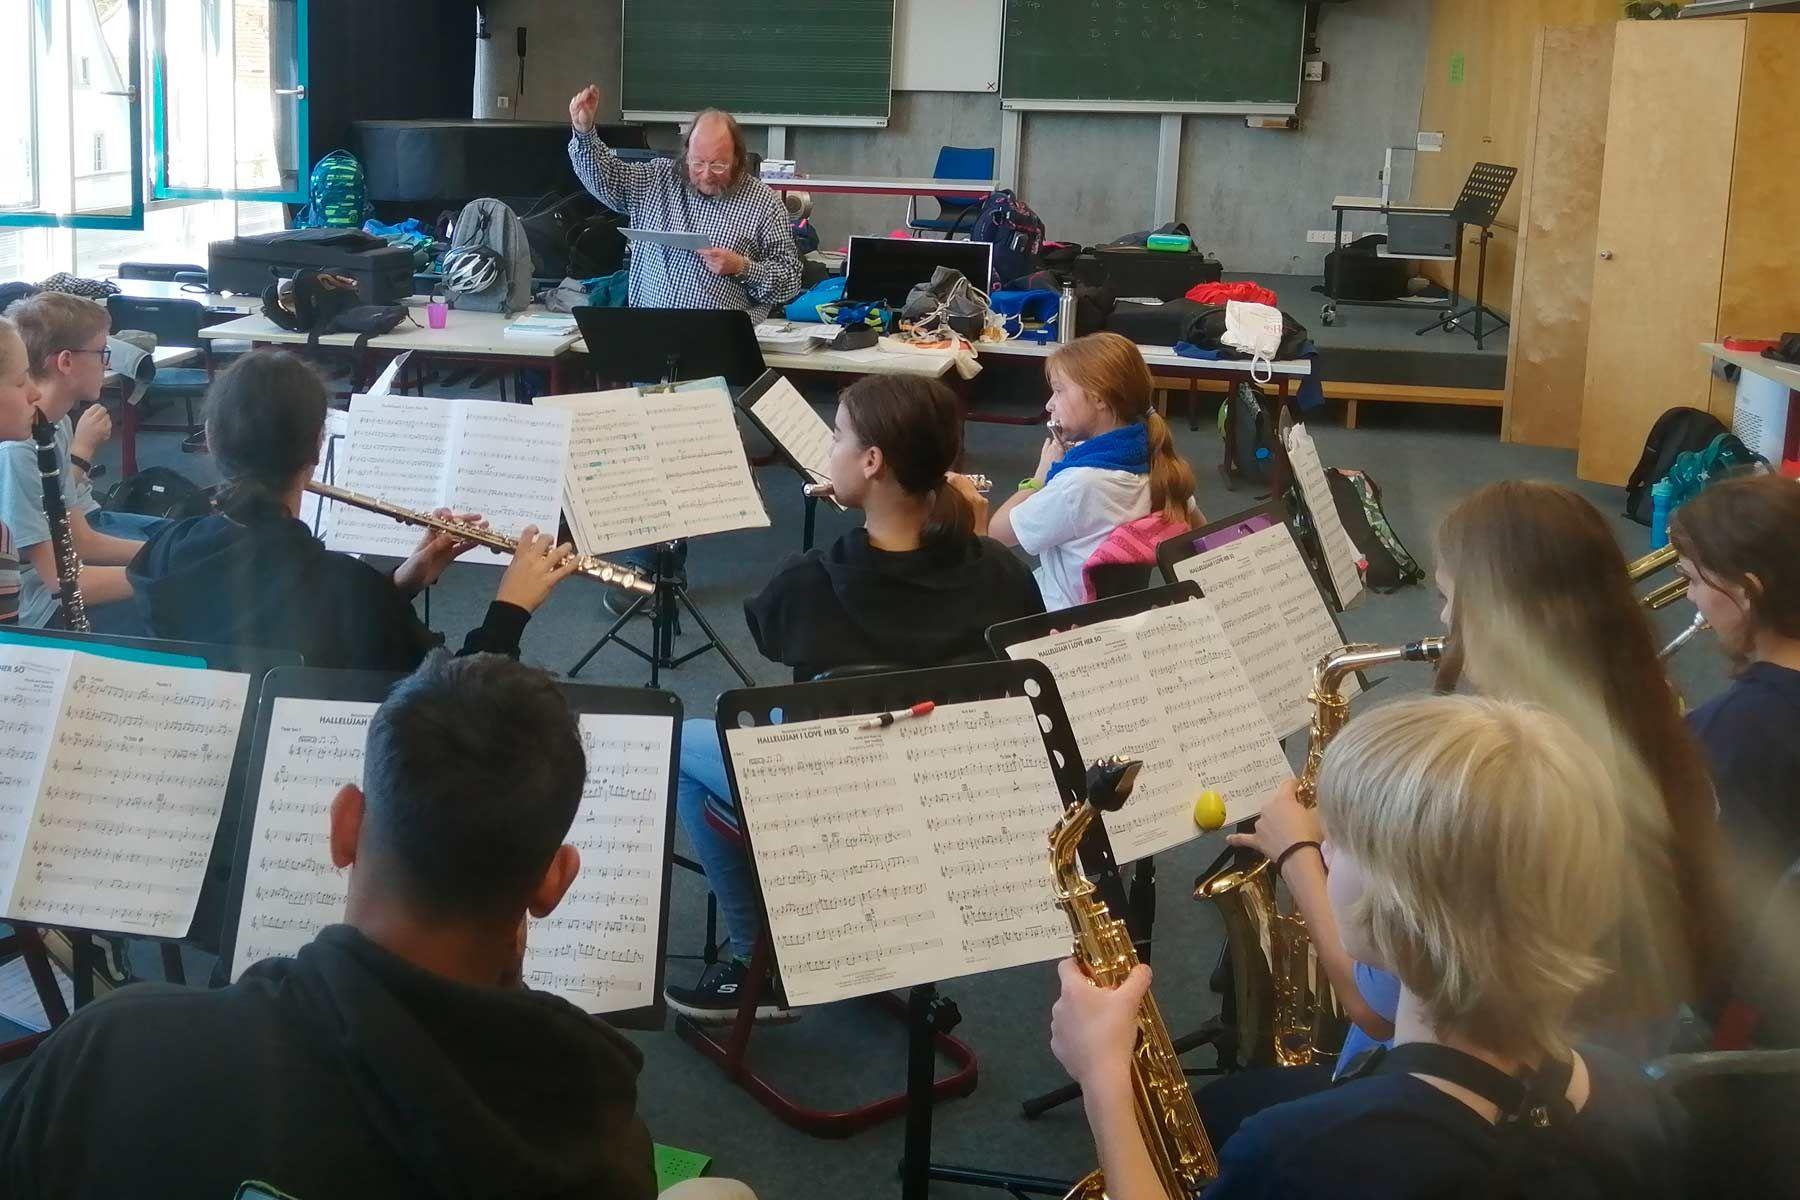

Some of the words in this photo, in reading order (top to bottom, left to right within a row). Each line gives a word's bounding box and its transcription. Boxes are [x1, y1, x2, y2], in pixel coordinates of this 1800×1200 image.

[1071, 641, 1084, 649] LOVE
[13, 665, 25, 674] SO
[319, 715, 368, 726] HALLELUJAH
[757, 732, 800, 745] HALLELUJAH
[804, 730, 823, 739] LOVE
[824, 728, 838, 737] HER
[839, 726, 850, 735] SO
